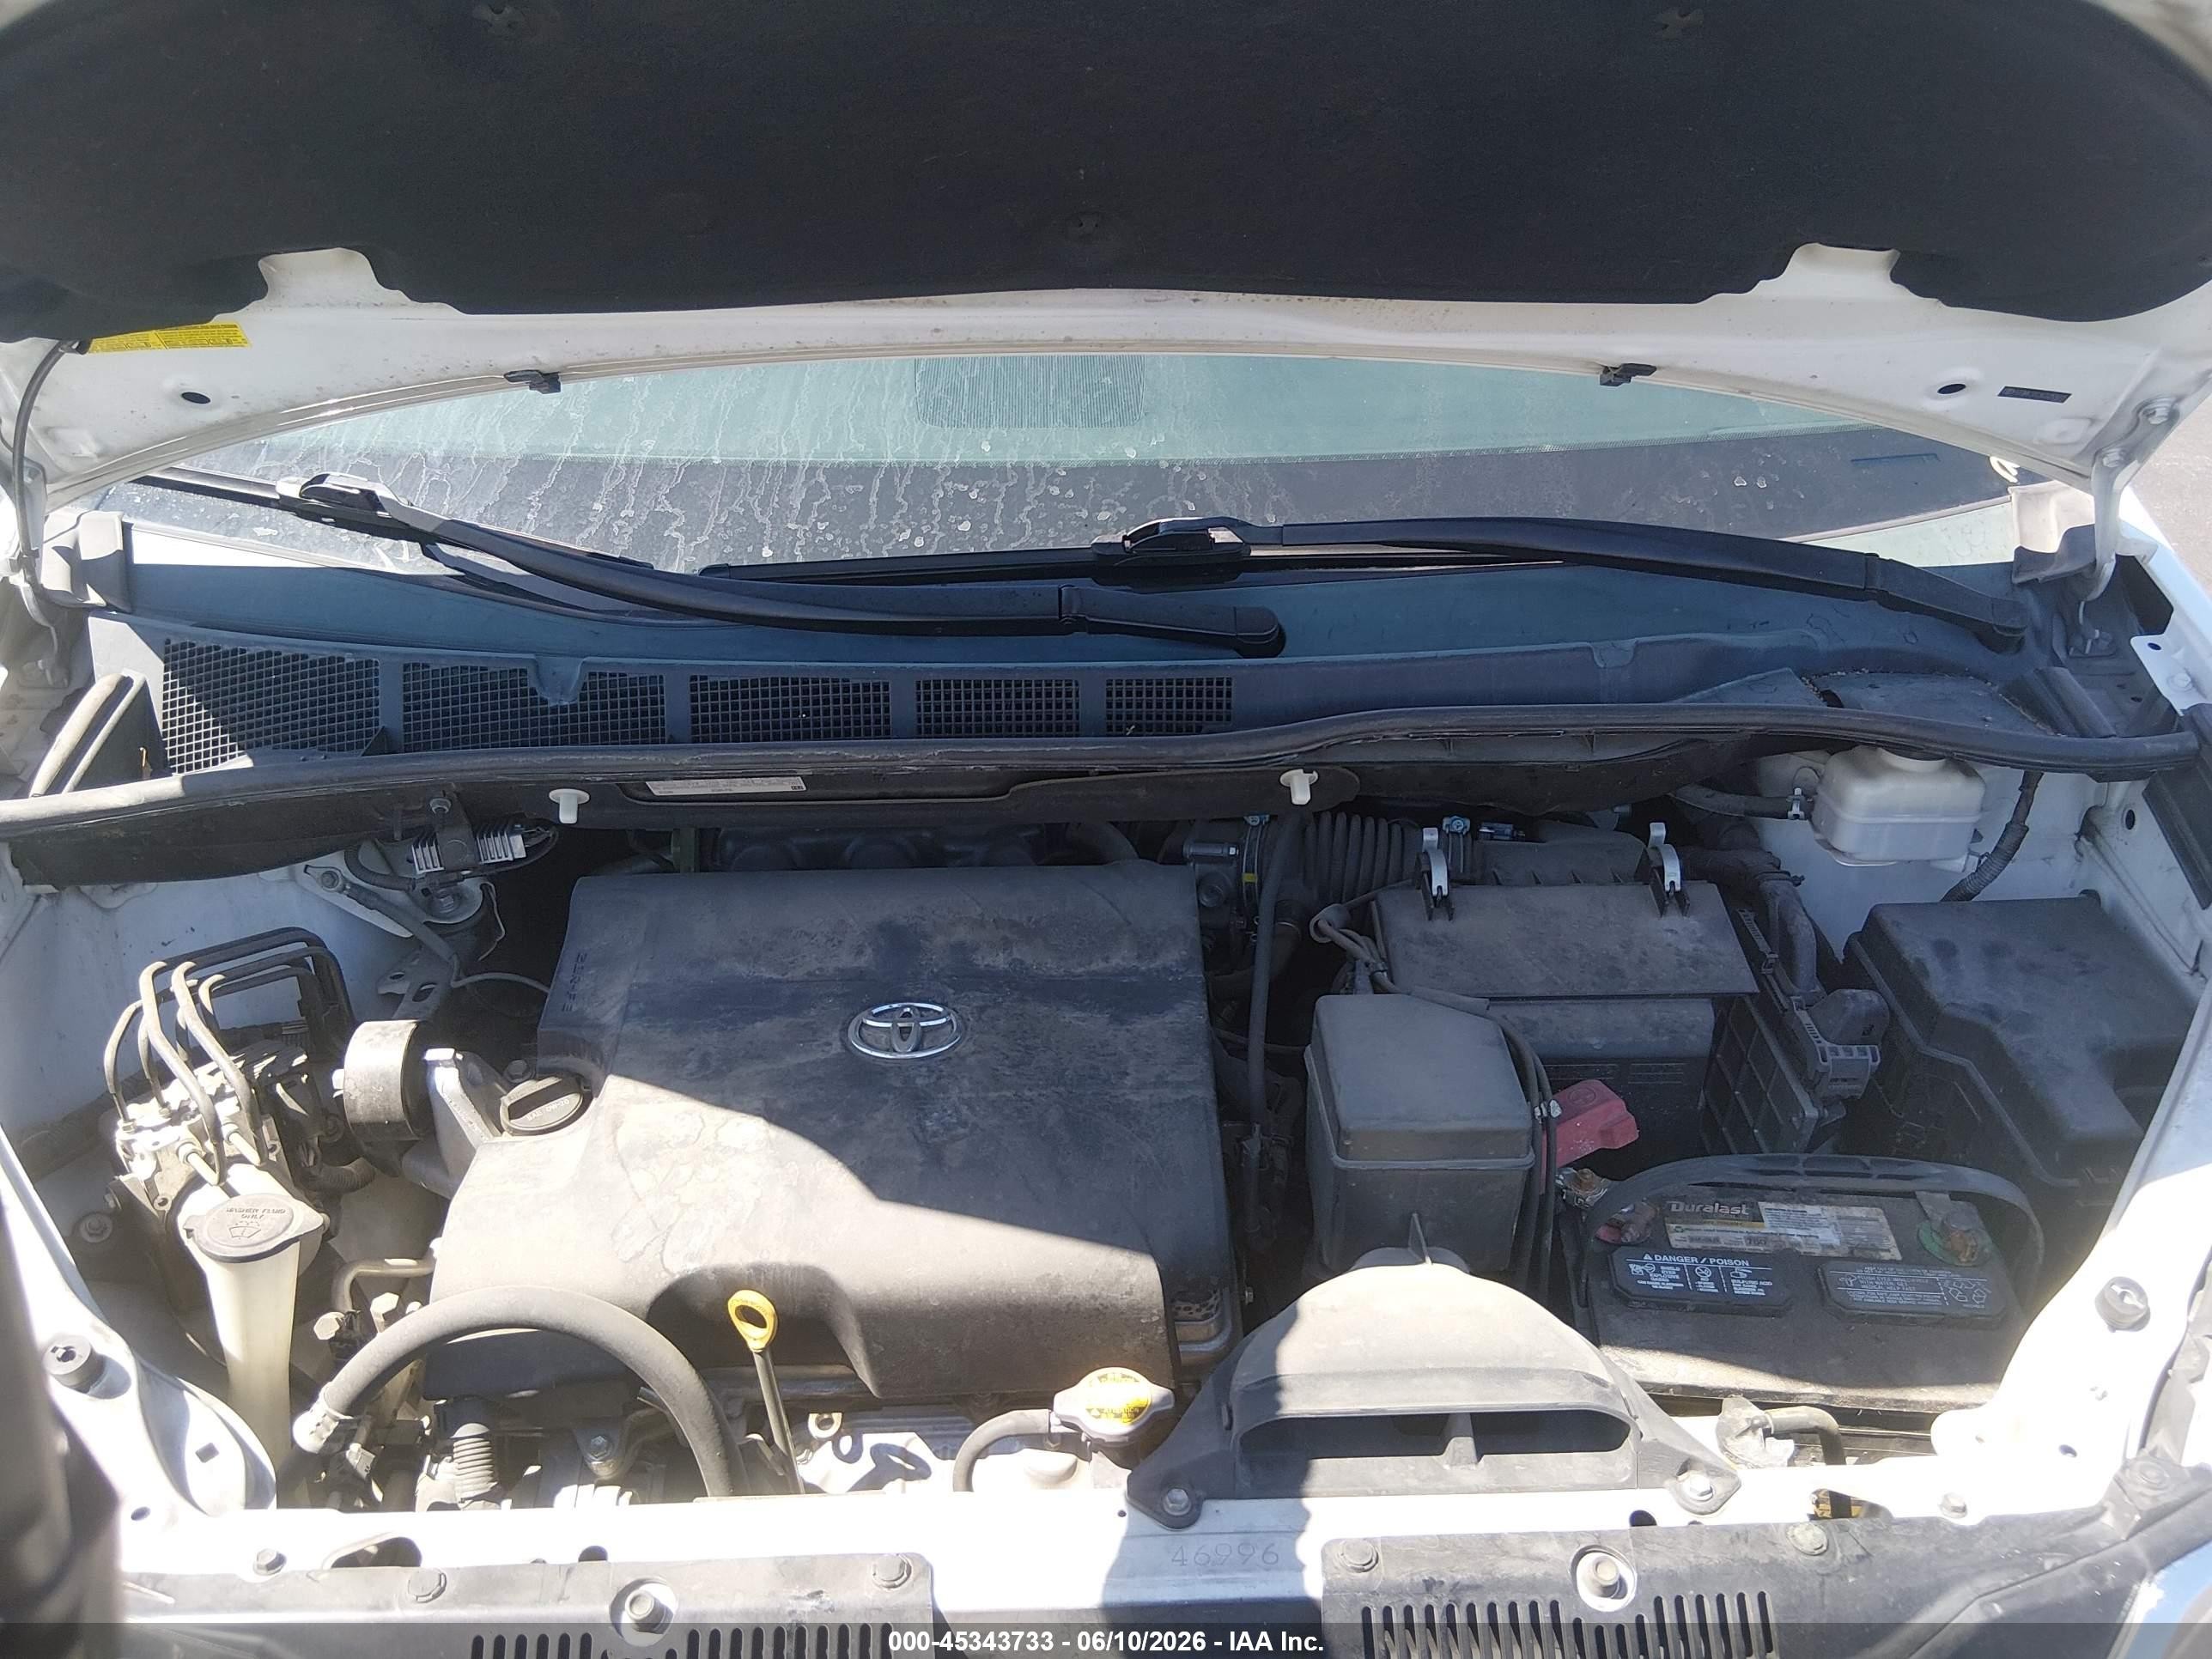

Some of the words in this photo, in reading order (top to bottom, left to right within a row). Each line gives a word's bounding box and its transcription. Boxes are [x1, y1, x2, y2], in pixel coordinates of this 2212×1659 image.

[1666, 1201, 1749, 1215] Duralast
[1654, 1254, 1698, 1264] DANGER
[1709, 1257, 1749, 1267] POISON
[1170, 1542, 1279, 1567] 46996
